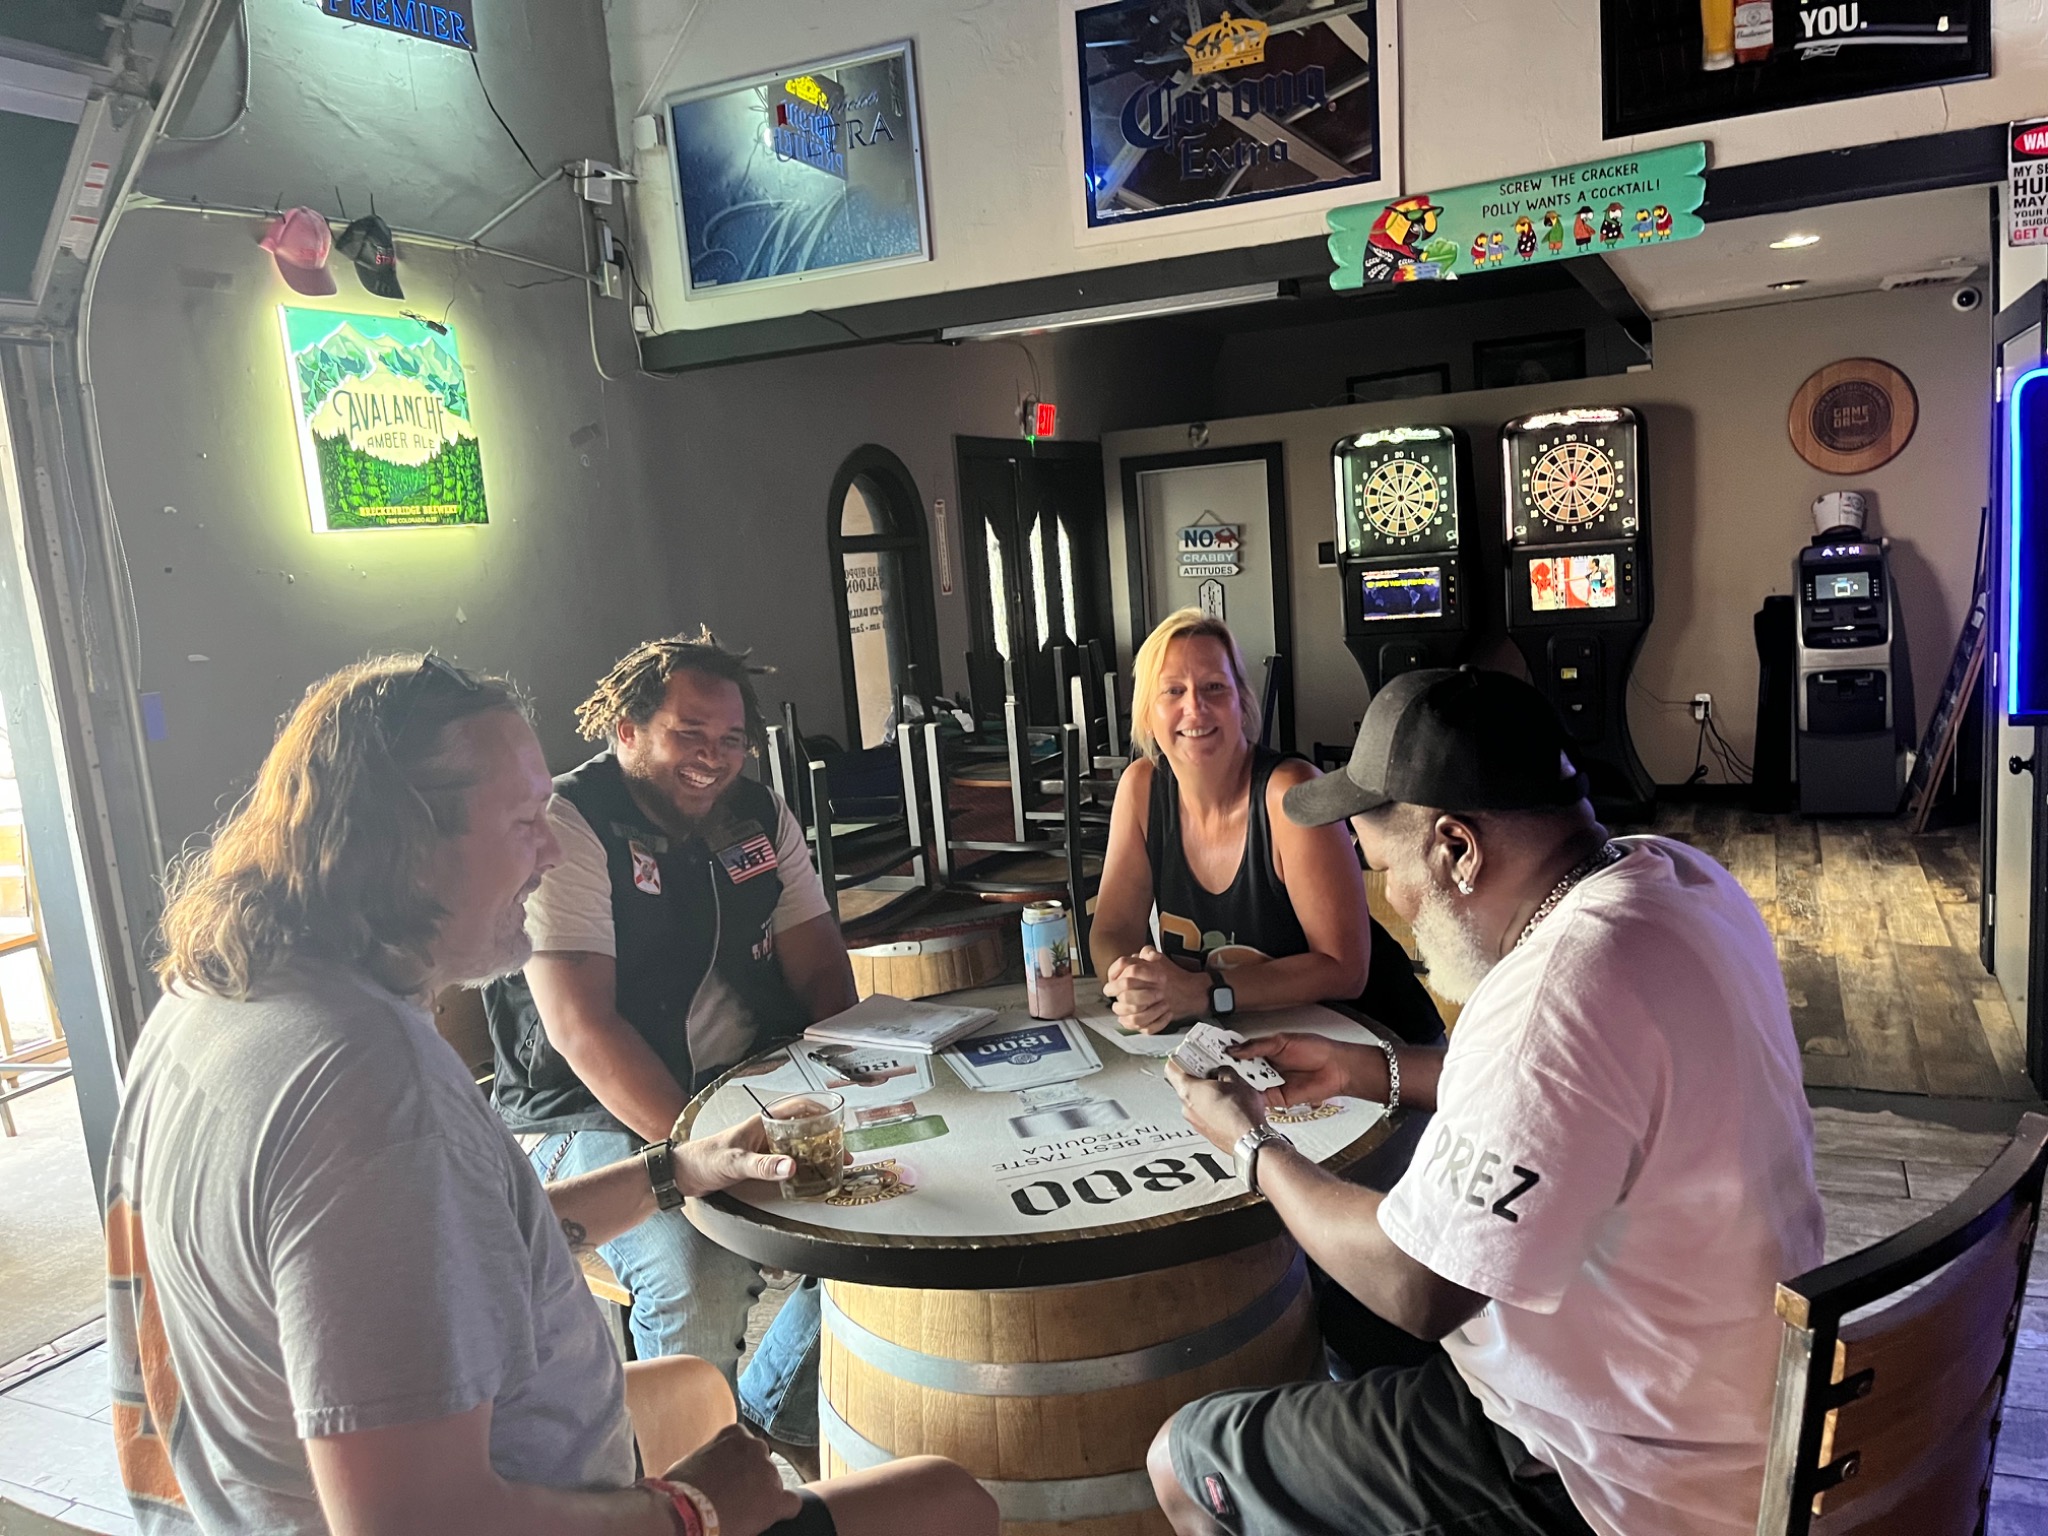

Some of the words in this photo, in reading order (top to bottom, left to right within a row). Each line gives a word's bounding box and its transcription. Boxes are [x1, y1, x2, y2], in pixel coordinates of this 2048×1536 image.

[1800, 2, 1868, 38] YOU.
[1120, 65, 1328, 154] Corona
[2023, 132, 2048, 151] WA
[1179, 132, 1289, 182] Extra
[1499, 178, 1542, 196] SCREW
[1551, 172, 1576, 188] THE
[1581, 162, 1639, 182] CRACKER
[2013, 164, 2033, 178] MY
[2013, 176, 2048, 197] HU
[1482, 201, 1521, 218] POLLY
[1526, 193, 1571, 211] WANTS
[1577, 190, 1587, 203] A
[1591, 179, 1660, 200] COCKTAIL!
[2013, 194, 2048, 209] MAY
[2014, 209, 2043, 218] YOUR
[2013, 227, 2039, 240] GET
[333, 390, 450, 441] AVALANCHE
[367, 431, 409, 448] AMBER
[413, 434, 435, 449] ALE
[1185, 529, 1214, 548] NO
[1183, 553, 1234, 562] CRABBY
[1821, 545, 1860, 557] ATM
[1183, 566, 1232, 575] ATTITUDES
[977, 1034, 1053, 1056] 1800
[1136, 1125, 1160, 1135] IN
[1152, 1128, 1200, 1143] THE
[1021, 1131, 1124, 1154] TEQUILA
[1080, 1138, 1142, 1157] BEST
[991, 1151, 1072, 1172] TASTE
[1423, 1124, 1540, 1223] PREZ
[1010, 1152, 1236, 1216] 1800
